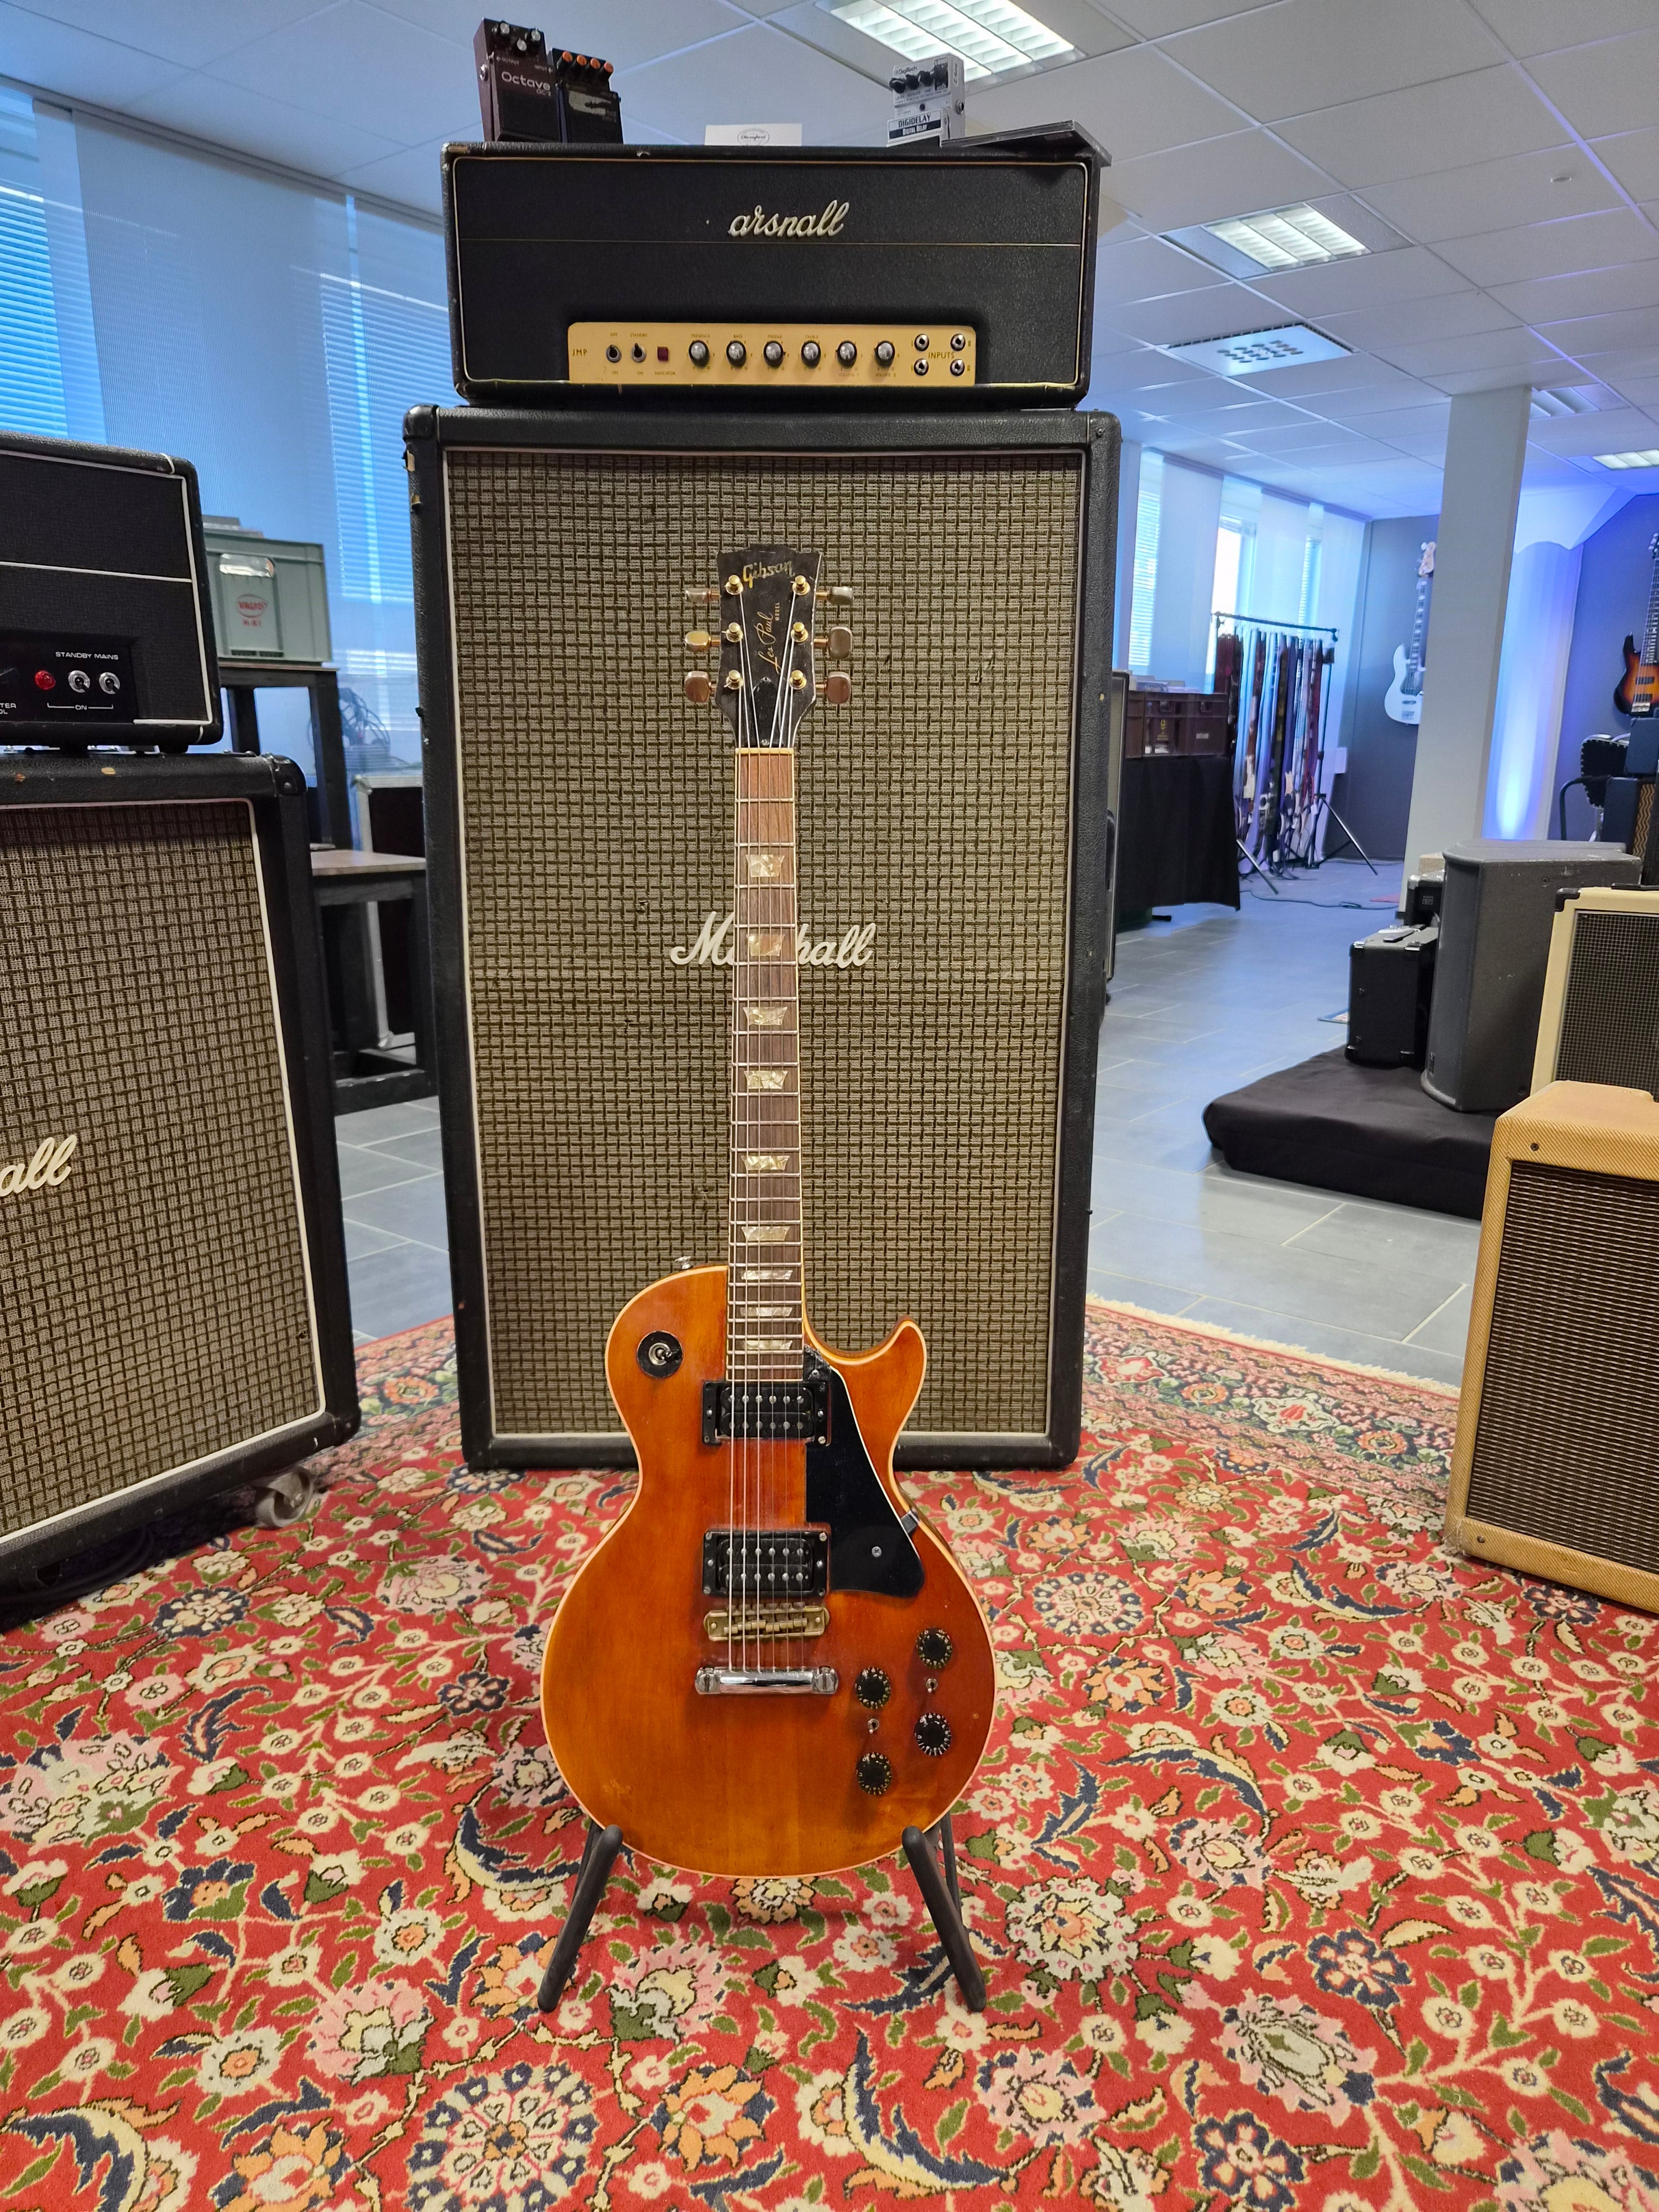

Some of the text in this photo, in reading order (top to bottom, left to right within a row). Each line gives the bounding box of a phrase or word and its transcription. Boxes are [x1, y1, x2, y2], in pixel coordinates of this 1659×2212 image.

[501, 71, 551, 90] Octave
[898, 113, 931, 128] DIGIDELAY
[743, 560, 796, 588] Gibson
[754, 611, 781, 675] Les Paul
